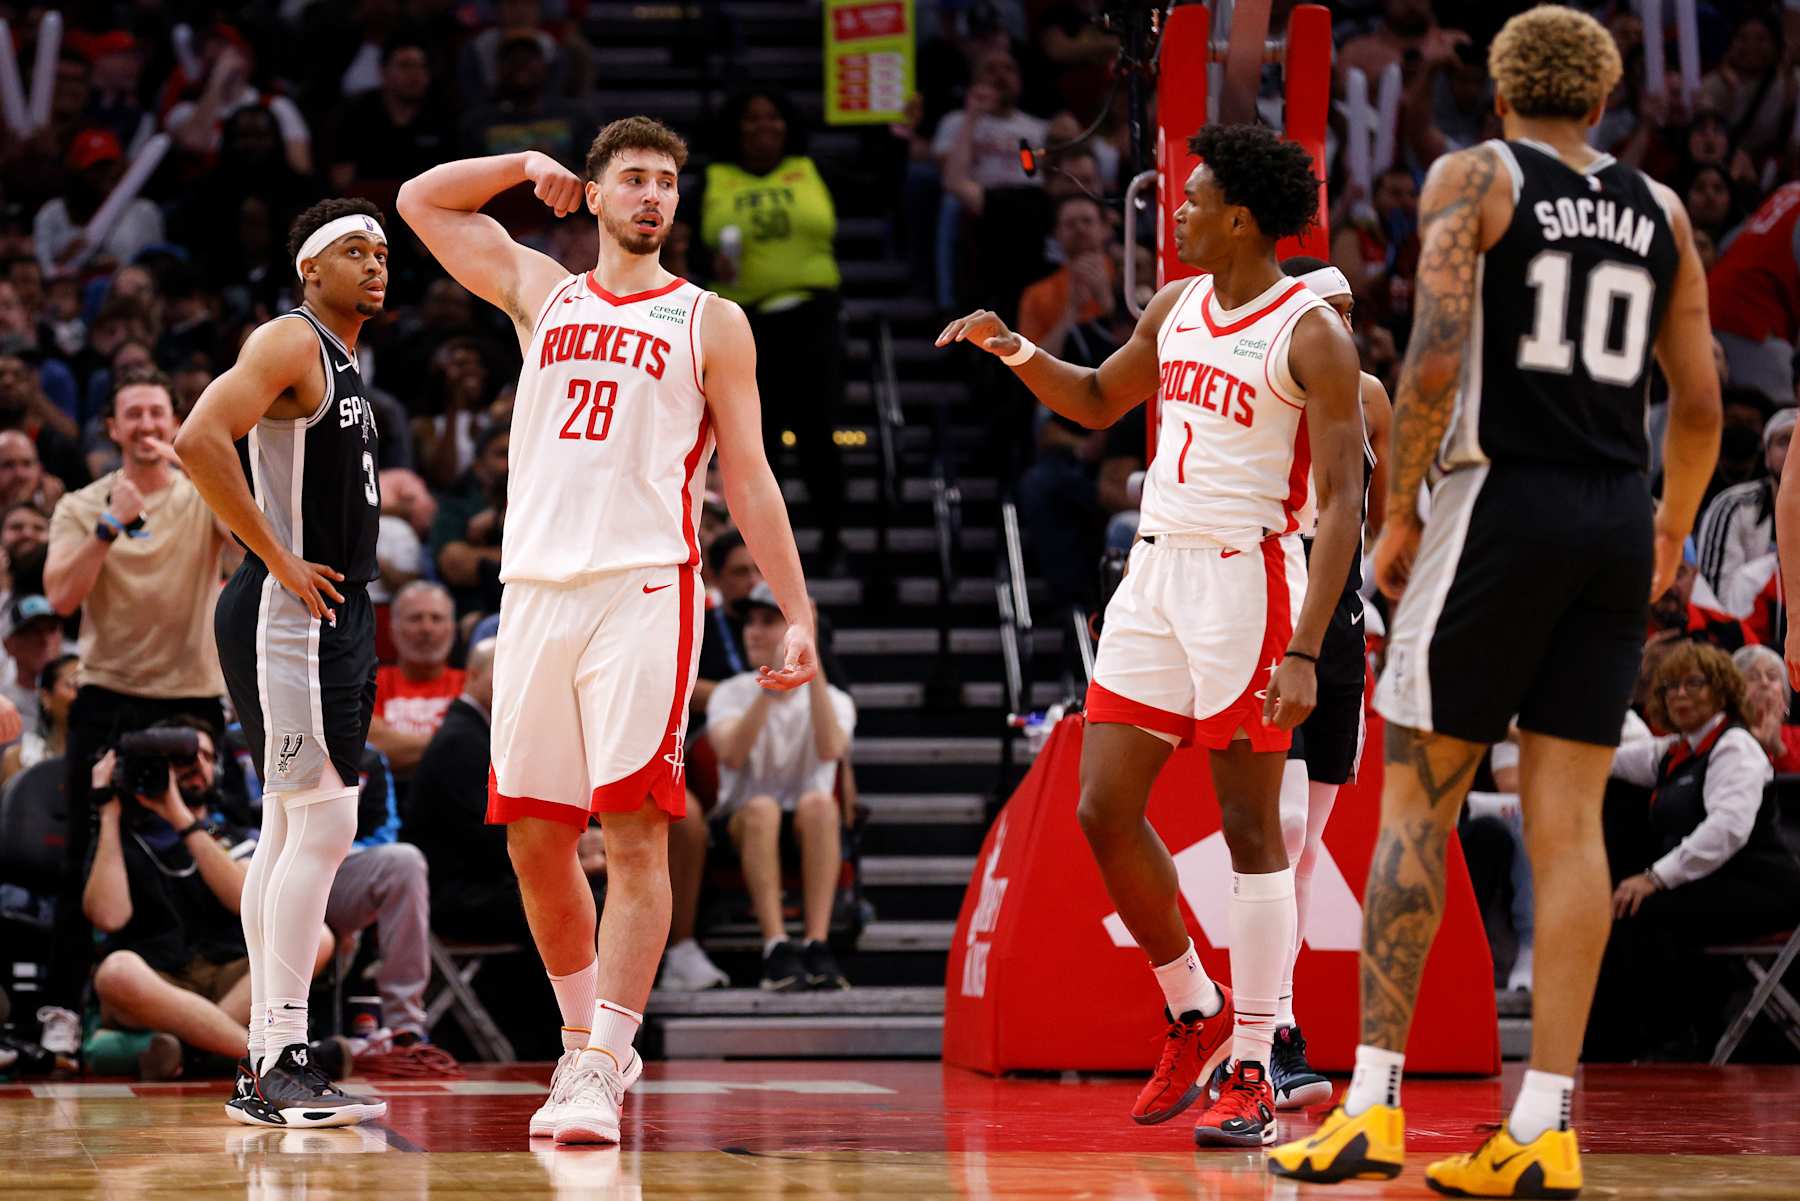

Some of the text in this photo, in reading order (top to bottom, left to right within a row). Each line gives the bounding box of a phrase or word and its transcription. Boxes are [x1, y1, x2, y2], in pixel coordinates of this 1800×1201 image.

[1534, 197, 1655, 257] SOCHAN
[650, 310, 685, 325] karma
[653, 304, 688, 318] credit
[1516, 249, 1656, 388] 10
[540, 323, 672, 381] ROCKETS
[1233, 345, 1264, 361] karma
[1239, 337, 1267, 350] credit
[559, 379, 619, 441] 28
[362, 450, 379, 507] 3
[1178, 421, 1193, 484] 1
